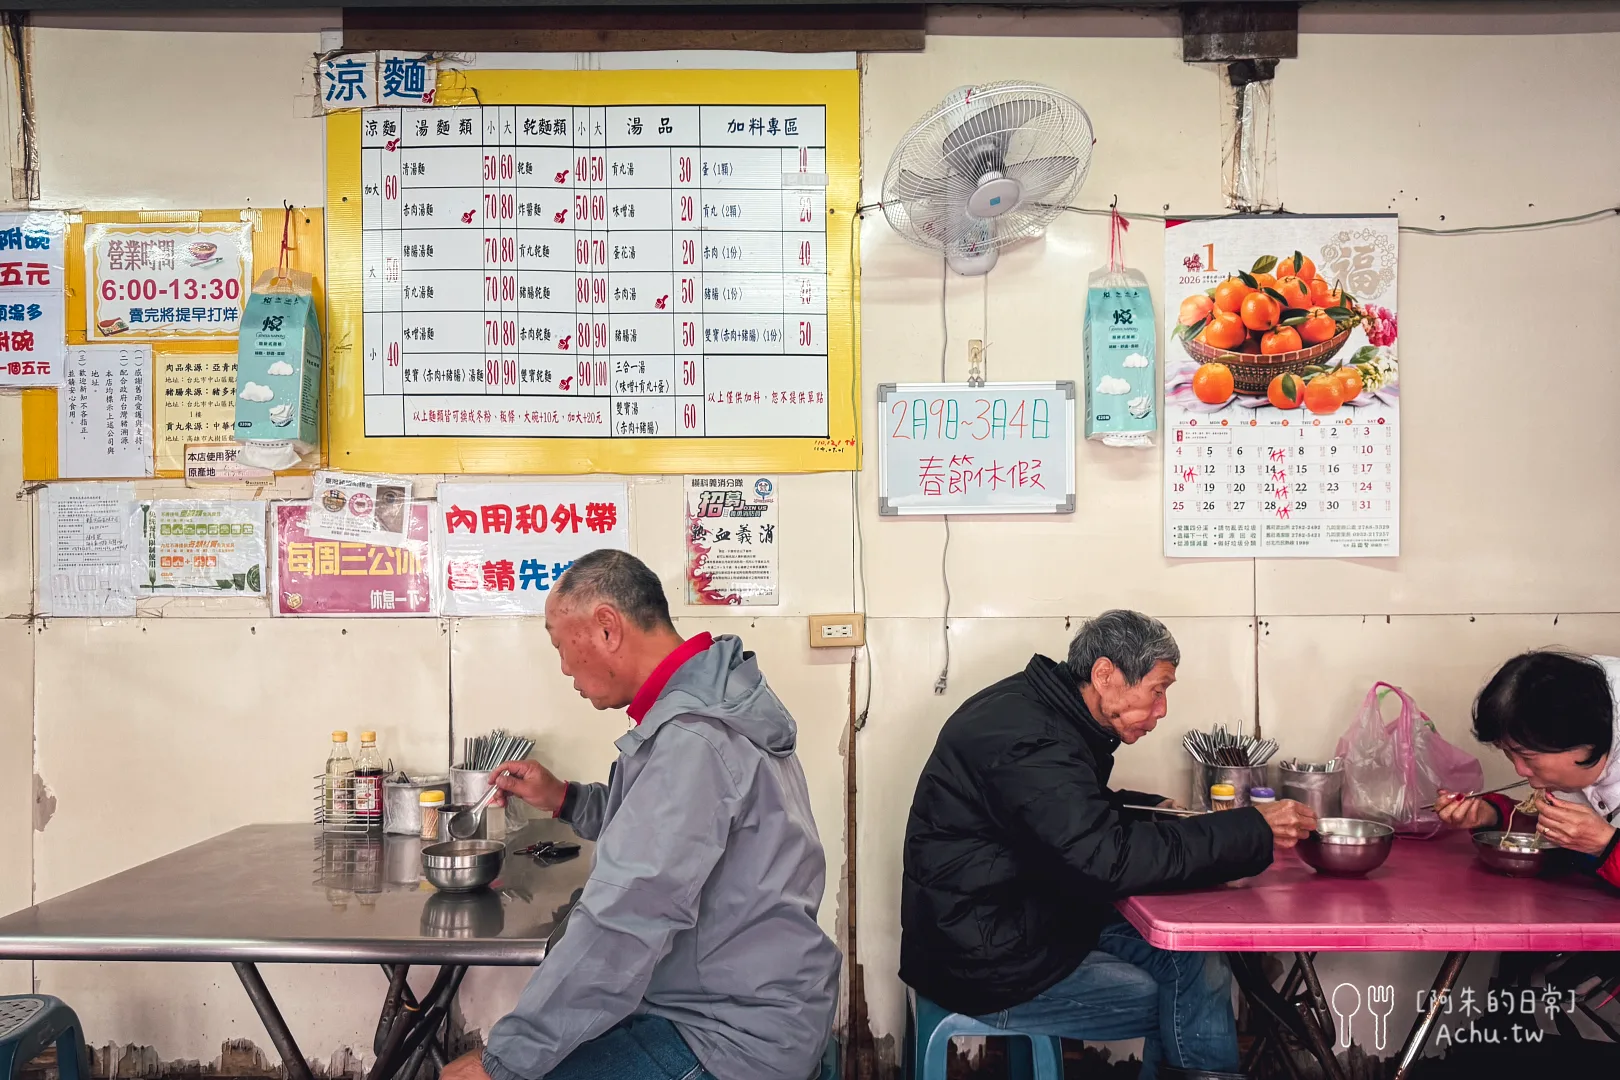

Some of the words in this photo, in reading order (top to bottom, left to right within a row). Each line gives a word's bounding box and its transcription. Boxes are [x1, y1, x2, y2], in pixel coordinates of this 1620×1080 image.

[325, 57, 425, 101] 涼麵
[365, 120, 397, 137] 涼麵
[415, 118, 473, 137] 湯麵類
[487, 123, 496, 136] 小
[504, 123, 512, 135] 大
[523, 118, 567, 135] 乾麵類
[577, 122, 586, 136] 小
[594, 122, 602, 135] 大
[627, 117, 673, 135] 湯品
[727, 118, 800, 136] 加料專區
[402, 162, 425, 176] 清湯麵
[484, 155, 497, 180] 50
[501, 154, 513, 179] 60
[517, 161, 533, 175] 乾麵
[575, 157, 587, 182] 40
[591, 156, 604, 182] 50
[679, 157, 691, 183] 30
[799, 147, 807, 172] 10
[364, 184, 380, 196] 加大
[385, 175, 397, 200] 60
[484, 194, 497, 220] 70
[501, 194, 513, 219] 80
[518, 203, 542, 217] 炸醬麵
[575, 195, 587, 220] 50
[592, 195, 604, 220] 60
[612, 204, 635, 218] 味噌湯
[681, 196, 693, 222] 20
[107, 239, 175, 271] 營業時間
[485, 238, 497, 263] 70
[501, 237, 514, 262] 80
[577, 240, 589, 264] 60
[593, 240, 605, 265] 70
[613, 246, 636, 259] 蛋花湯
[682, 240, 695, 265] 20
[799, 241, 810, 265] 40
[1203, 243, 1218, 272] 1
[0, 262, 50, 286] 五元
[369, 265, 376, 278] 大
[1179, 276, 1200, 284] 2026
[1332, 245, 1381, 294] 福
[102, 279, 239, 300] 6:00-13:30
[486, 277, 497, 301] 70
[502, 276, 514, 301] 80
[577, 278, 589, 303] 80
[594, 279, 606, 303] 90
[681, 278, 693, 304] 50
[129, 307, 238, 324] 賣完將提早打烊
[486, 321, 498, 345] 70
[503, 321, 515, 345] 80
[578, 323, 590, 347] 80
[594, 323, 606, 348] 90
[683, 322, 695, 347] 50
[800, 322, 811, 346] 50
[370, 349, 377, 360] 小
[387, 342, 399, 367] 40
[0, 361, 50, 376] 一個五元
[487, 360, 499, 385] 80
[504, 360, 516, 385] 90
[579, 362, 591, 386] 90
[595, 362, 607, 386] 100
[616, 361, 646, 374] 三合一湯
[683, 361, 695, 386] 50
[684, 404, 696, 428] 60
[892, 399, 1050, 440] 2月9日~3月4日
[1364, 427, 1369, 435] 3
[188, 450, 240, 462] 本店使用豬
[1176, 447, 1182, 455] 4
[1207, 447, 1212, 455] 5
[1237, 447, 1242, 455] 6
[1299, 447, 1304, 455] 8
[1331, 446, 1336, 454] 9
[1362, 445, 1373, 453] 10
[1269, 449, 1286, 464] 休
[189, 468, 215, 477] 原產地
[919, 455, 1045, 495] 春節休假
[1174, 465, 1183, 473] 11
[1205, 465, 1215, 473] 12
[1235, 465, 1245, 473] 13
[1265, 465, 1276, 473] 14
[1297, 465, 1307, 473] 15
[1328, 465, 1339, 473] 16
[1361, 464, 1372, 472] 17
[1183, 467, 1198, 483] 休
[1174, 483, 1184, 491] 18
[1205, 483, 1214, 491] 19
[1265, 483, 1275, 491] 21
[1295, 483, 1307, 491] 22
[1327, 483, 1339, 491] 23
[1360, 482, 1372, 490] 24
[698, 491, 742, 517] 招募
[1173, 502, 1184, 510] 25
[1203, 502, 1214, 510] 26
[1265, 502, 1276, 510] 28
[1295, 501, 1307, 509] 29
[1327, 501, 1339, 509] 30
[1360, 501, 1371, 509] 31
[446, 502, 617, 534] 內用和外帶
[692, 524, 775, 544] 熱血義消
